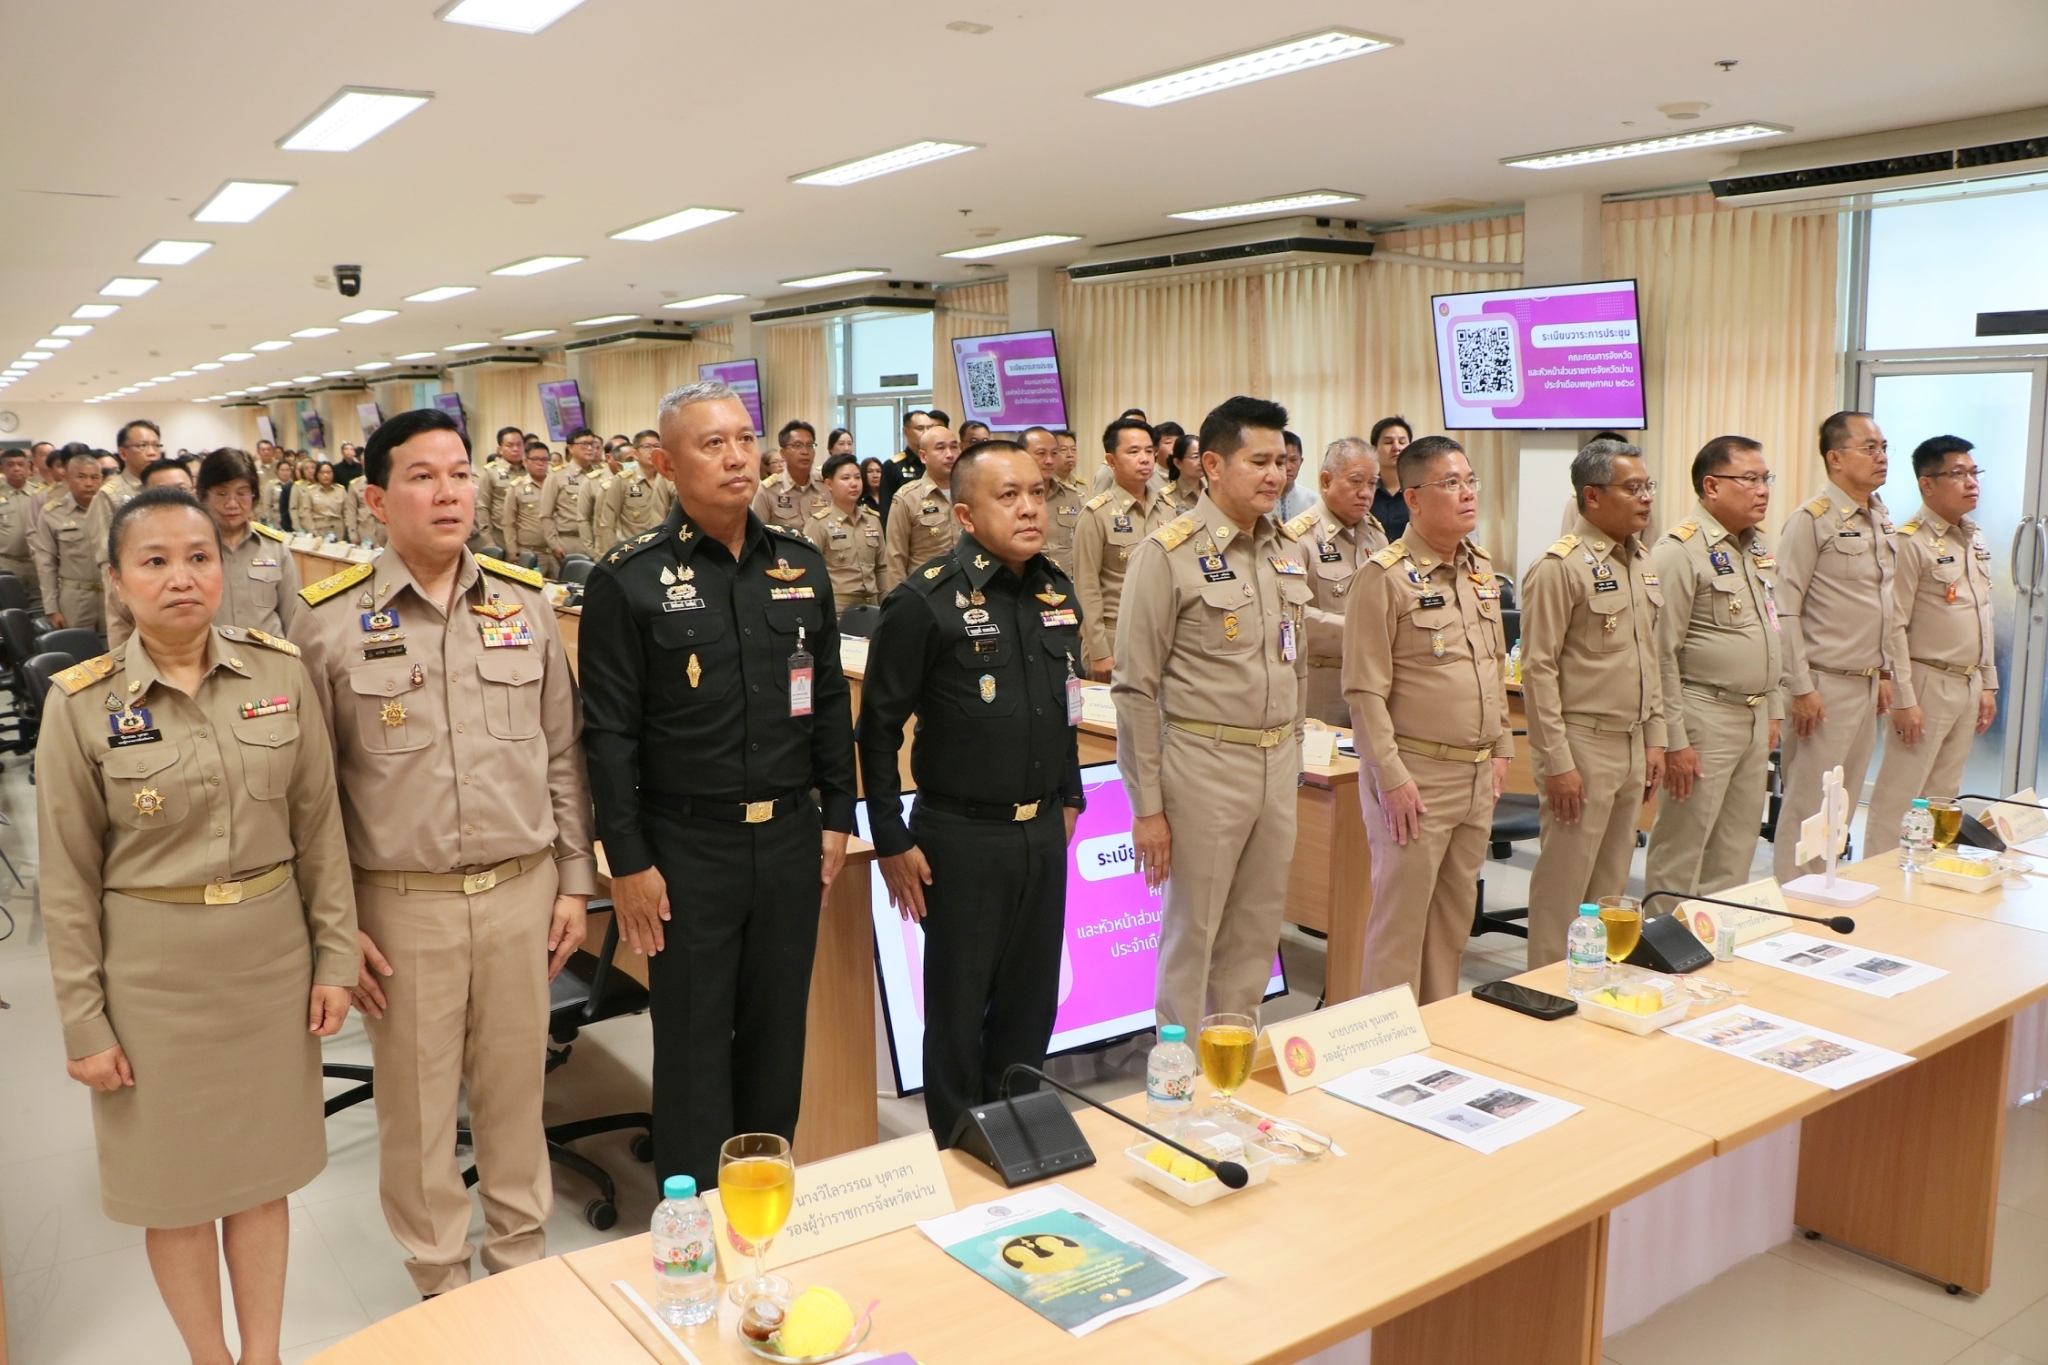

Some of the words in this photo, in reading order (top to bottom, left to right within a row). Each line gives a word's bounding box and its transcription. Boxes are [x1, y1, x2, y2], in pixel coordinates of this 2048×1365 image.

[1542, 328, 1630, 341] ระเบียบวาระการประชุม
[1077, 909, 1163, 939] และหัวหน้าส่วน
[1323, 1024, 1417, 1062] รองผู้ว่าราชการจังหวัดน่าน
[795, 1176, 872, 1208] นางวิไลวรรณ
[875, 1164, 914, 1188] บุดาสา
[786, 1184, 936, 1237] รองผู้ว่าราชการจังหวัดน่าน
